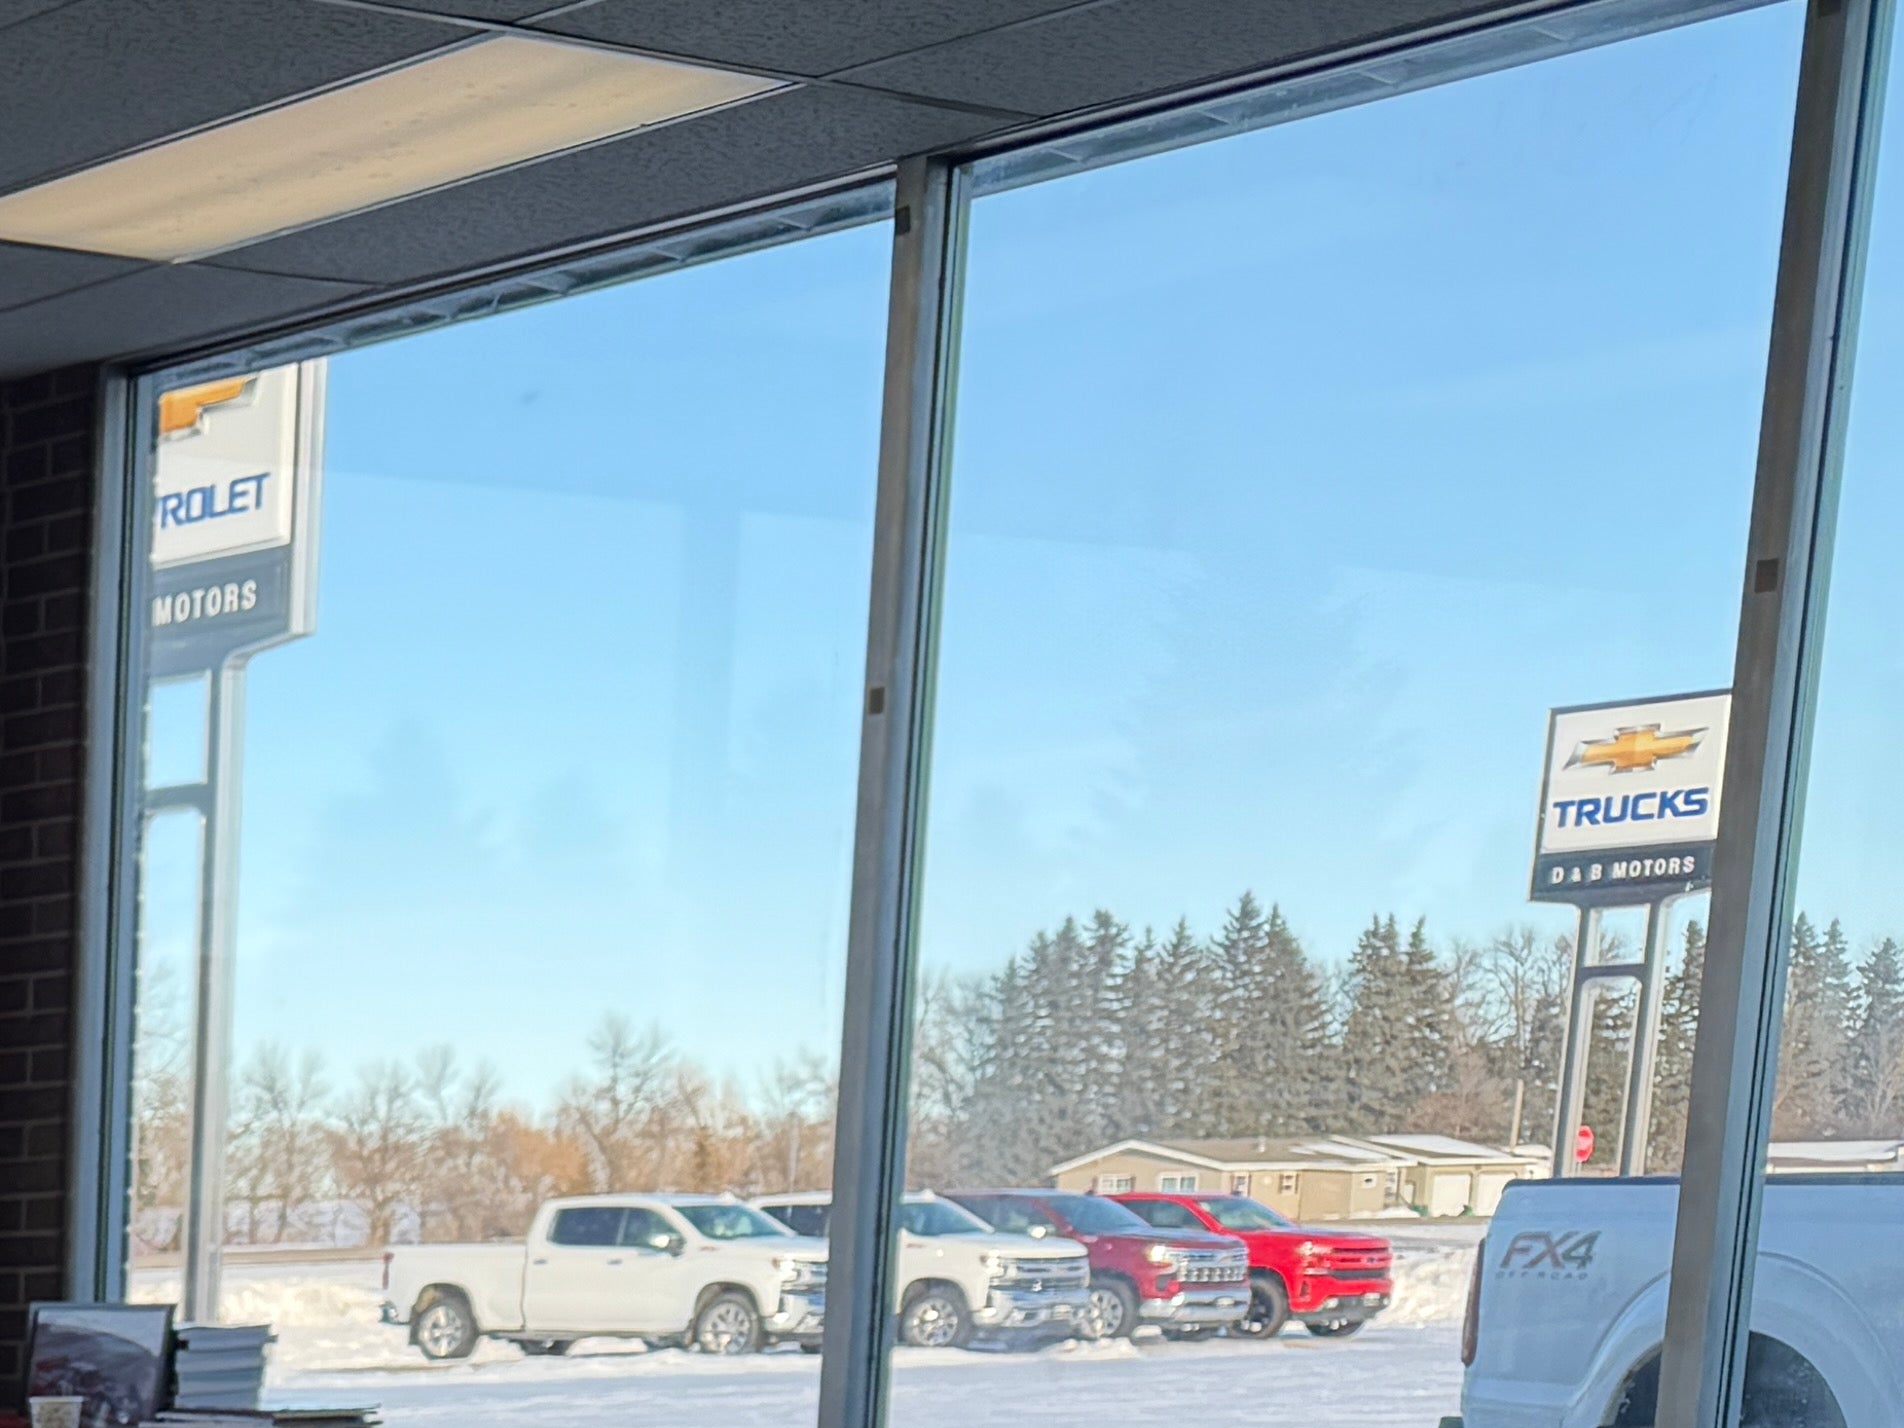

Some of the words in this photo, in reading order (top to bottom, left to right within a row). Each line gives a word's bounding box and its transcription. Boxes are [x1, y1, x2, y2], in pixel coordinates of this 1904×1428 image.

[156, 472, 271, 530] ROLET
[152, 578, 258, 628] MOTORS
[1552, 786, 1710, 828] TRUCKS
[1551, 865, 1565, 885] D
[1570, 866, 1583, 883] &
[1589, 862, 1603, 882] B
[1611, 855, 1696, 880] MOTORS
[1499, 1230, 1603, 1270] FX4
